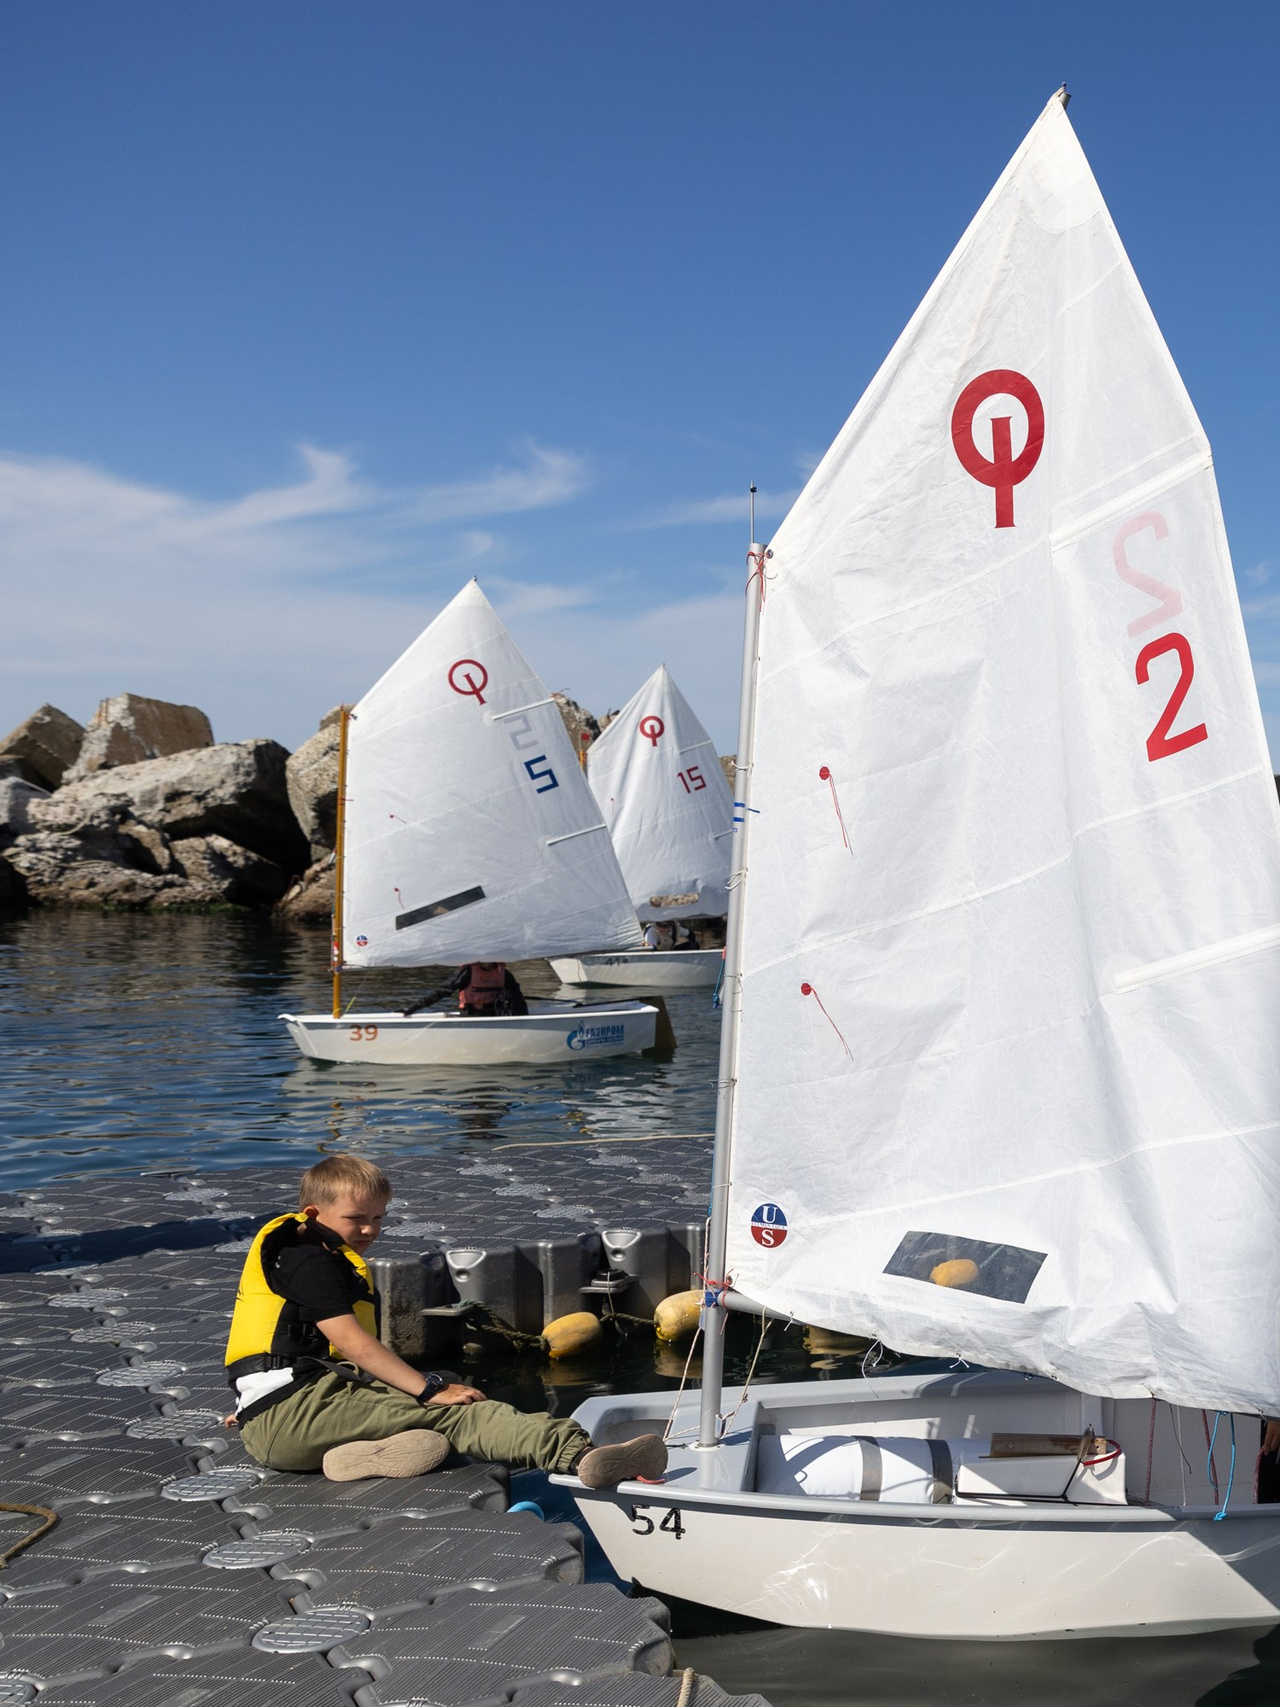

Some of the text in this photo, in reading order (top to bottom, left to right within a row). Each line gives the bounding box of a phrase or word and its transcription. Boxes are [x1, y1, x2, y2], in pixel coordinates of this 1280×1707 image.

[1135, 632, 1209, 762] 2
[523, 754, 559, 794] 5
[676, 765, 706, 794] 15
[350, 1024, 378, 1041] 39
[586, 1025, 624, 1038] ГАЗПРОМ
[762, 1205, 778, 1224] U
[761, 1229, 775, 1246] S
[631, 1504, 686, 1540] 54
